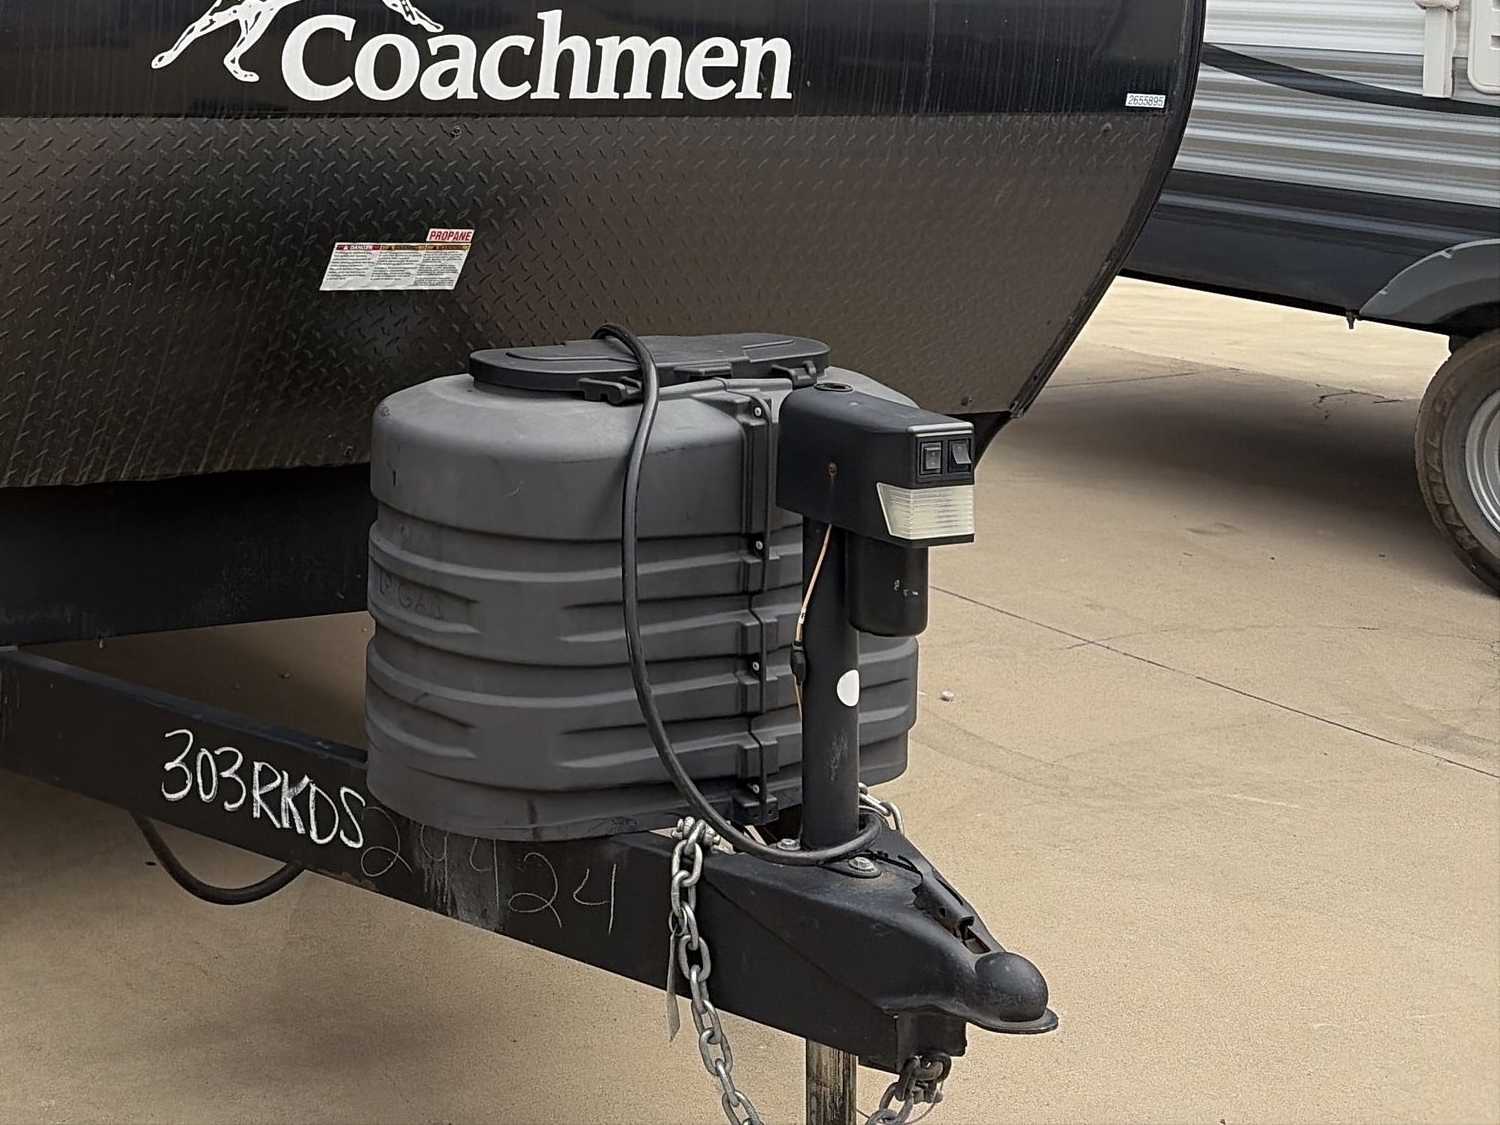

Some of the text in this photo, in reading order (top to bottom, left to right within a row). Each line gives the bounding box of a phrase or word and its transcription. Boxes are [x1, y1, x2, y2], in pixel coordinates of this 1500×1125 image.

[281, 9, 794, 102] Coachmen
[1127, 94, 1165, 107] 2655895
[429, 230, 472, 241] PROPANE
[160, 728, 367, 850] 303RKDS
